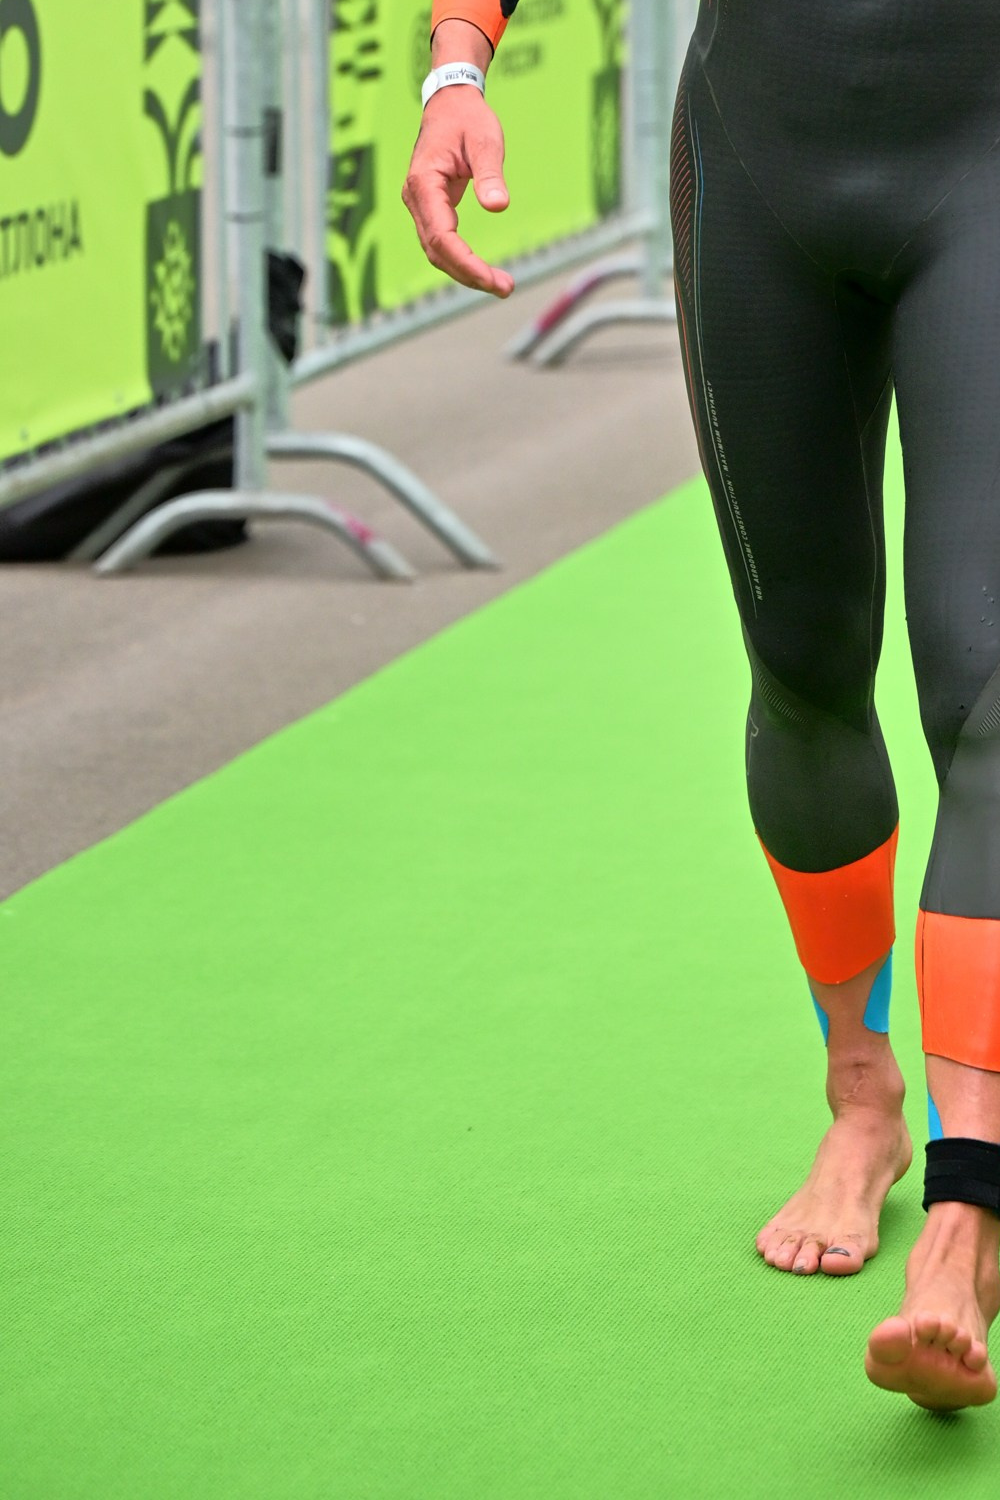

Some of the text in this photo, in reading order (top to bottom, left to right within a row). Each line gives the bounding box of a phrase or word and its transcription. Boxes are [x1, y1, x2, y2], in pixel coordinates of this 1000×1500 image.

[706, 380, 719, 428] BUOYANCY
[715, 430, 729, 472] MAXIMUM
[727, 480, 749, 541] CONSTRUCTION
